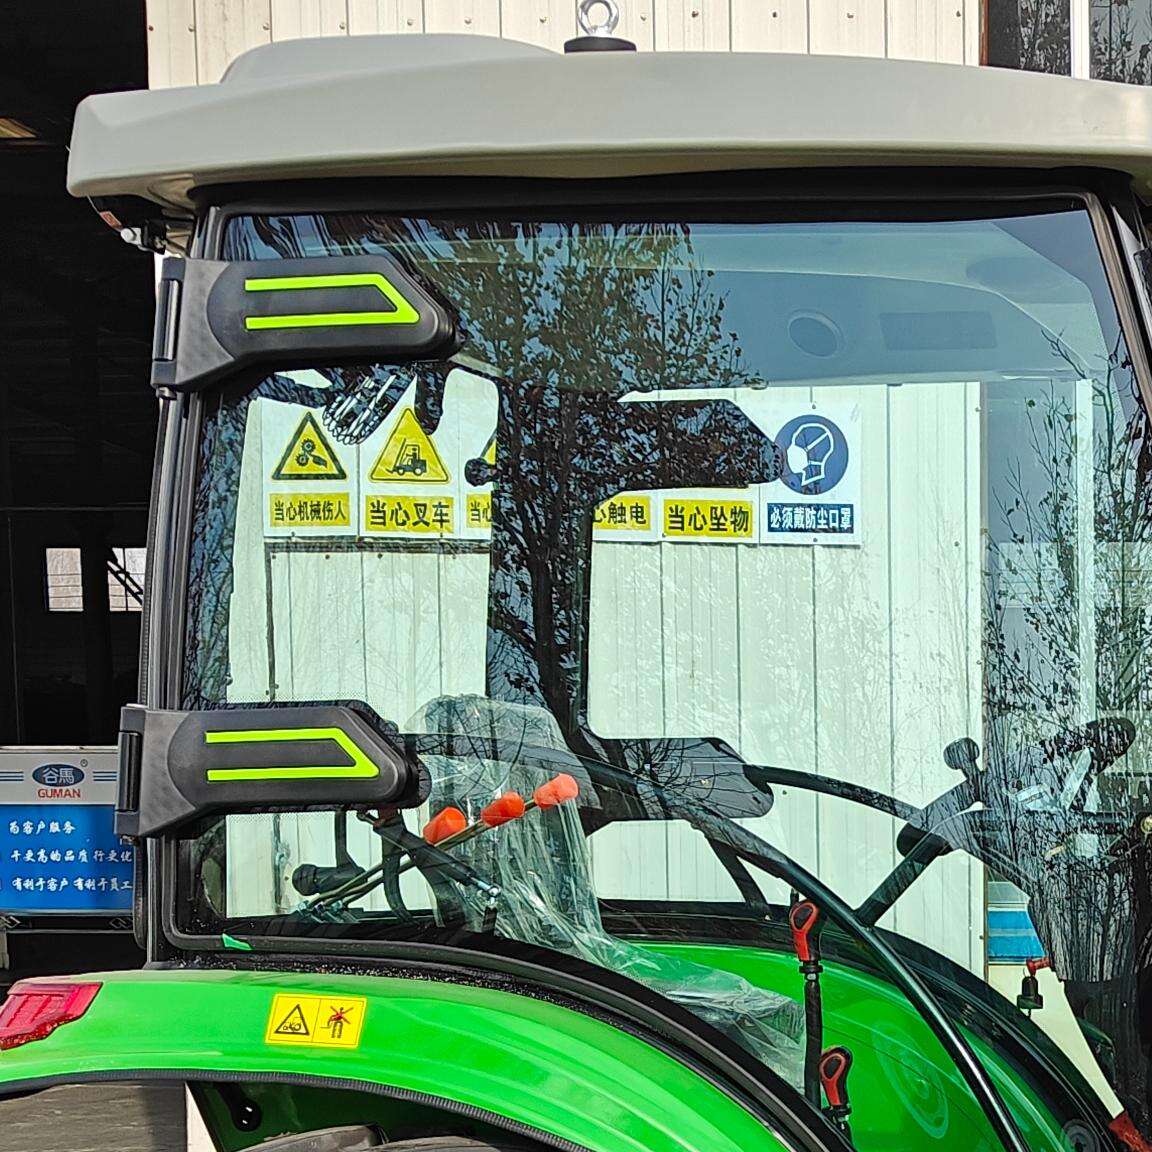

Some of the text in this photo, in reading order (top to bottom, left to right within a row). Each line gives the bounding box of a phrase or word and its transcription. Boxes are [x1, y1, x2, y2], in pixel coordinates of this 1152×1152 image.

[274, 499, 347, 522] 当心机械伤人
[369, 499, 451, 529] 当心叉车
[667, 506, 751, 533] 当心坠物
[770, 506, 852, 531] 必须戴防尘口罩
[37, 788, 81, 798] GUMAN
